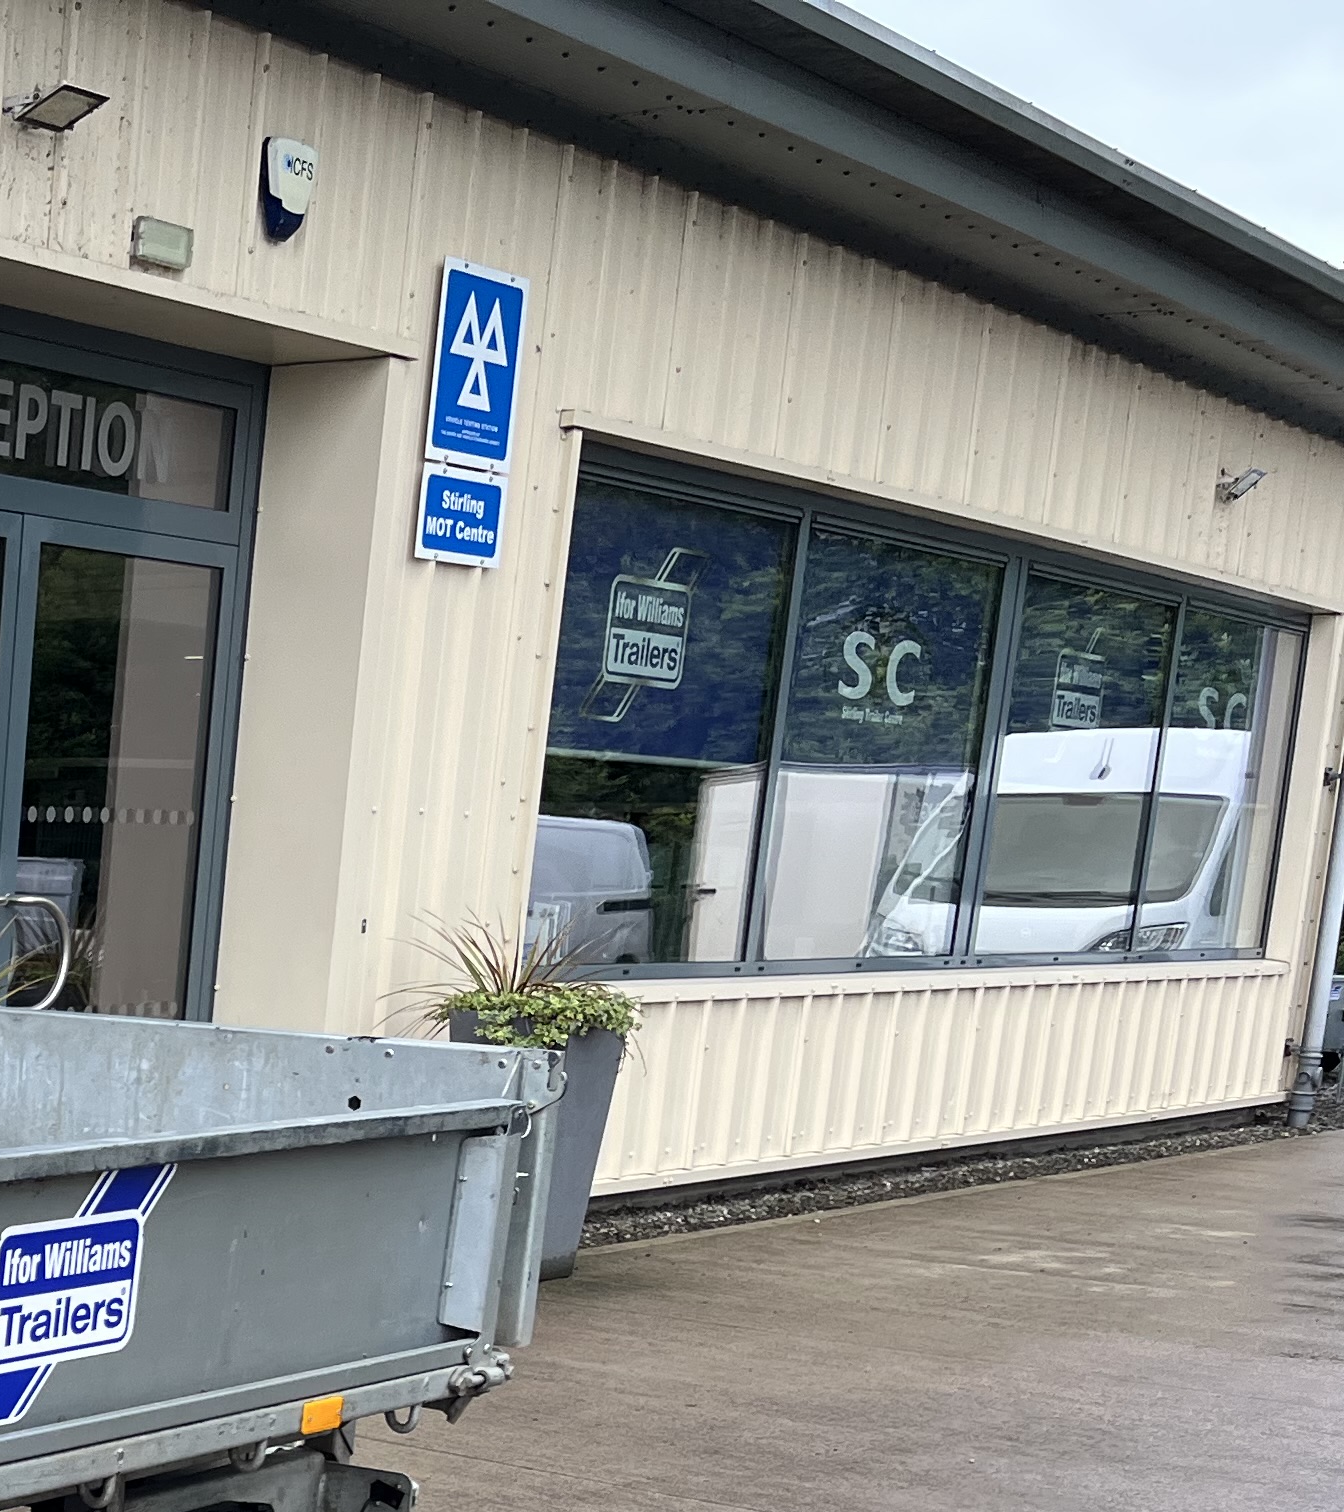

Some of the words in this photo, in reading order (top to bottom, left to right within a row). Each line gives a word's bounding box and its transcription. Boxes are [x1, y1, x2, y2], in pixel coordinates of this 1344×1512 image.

[442, 489, 485, 520] Stirling
[425, 515, 454, 538] MOT
[455, 520, 495, 545] Centre
[615, 590, 637, 620] Ifor
[637, 594, 685, 628] Williams
[612, 633, 679, 671] Trailers
[2, 1248, 42, 1287] Ifor
[43, 1237, 133, 1281] Williams
[0, 1295, 124, 1348] Trailers
